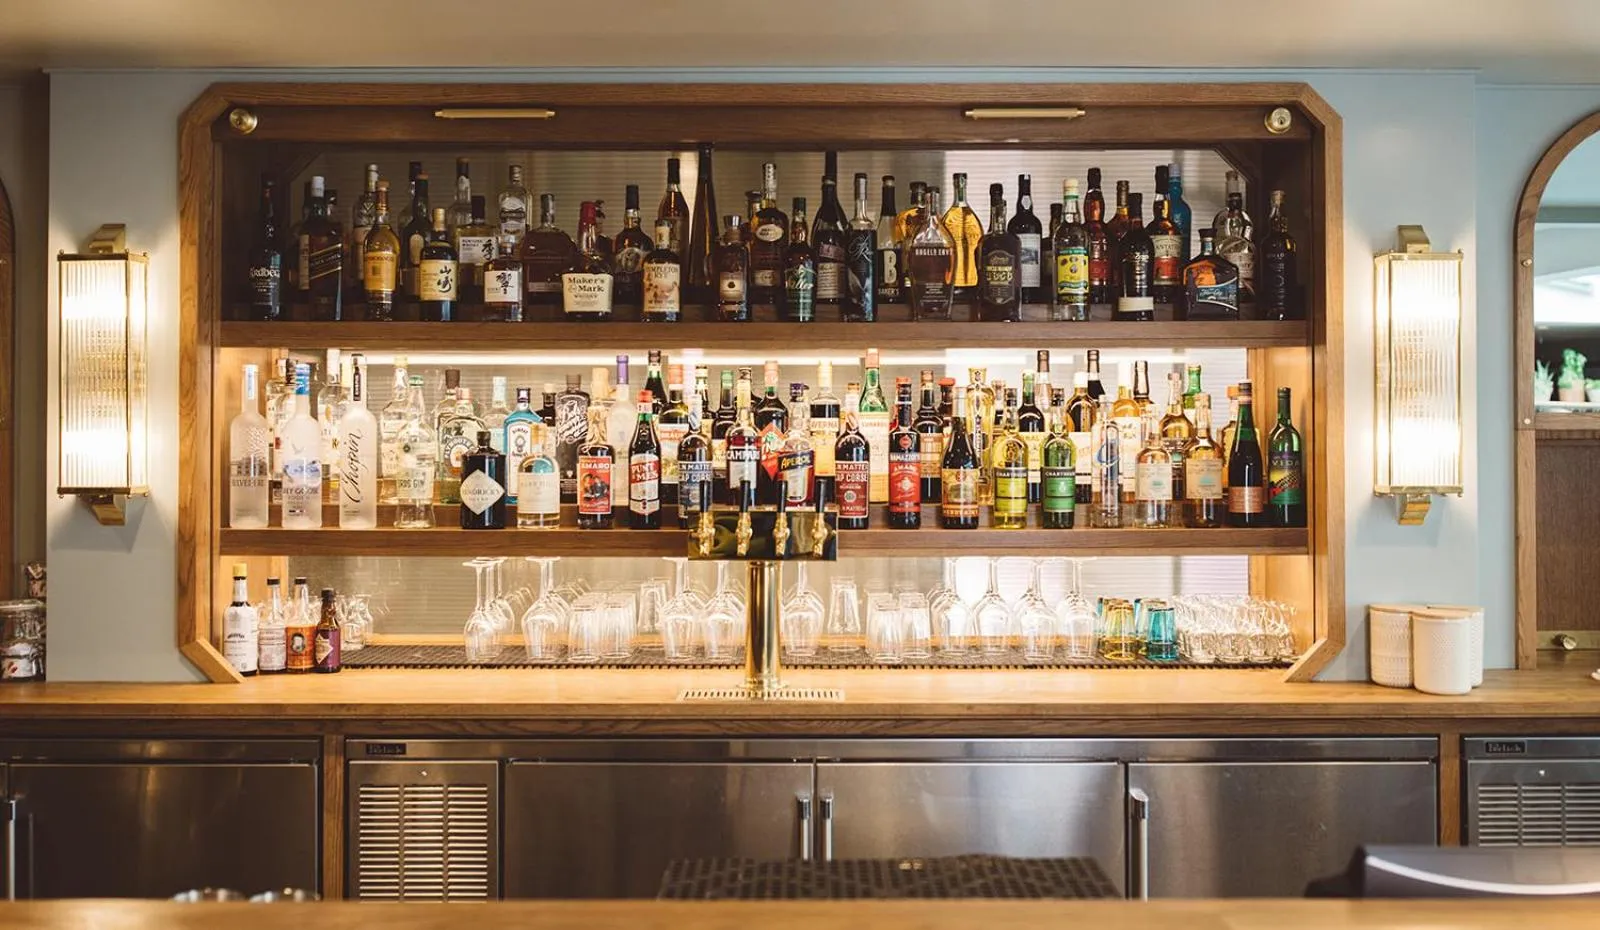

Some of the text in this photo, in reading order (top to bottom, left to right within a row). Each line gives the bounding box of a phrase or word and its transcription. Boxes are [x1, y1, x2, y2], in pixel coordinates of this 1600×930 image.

[567, 276, 606, 285] Maker's
[578, 284, 605, 292] Mark
[727, 449, 760, 461] CAMPARI
[780, 453, 811, 469] APEROL
[341, 428, 370, 503] Chopin
